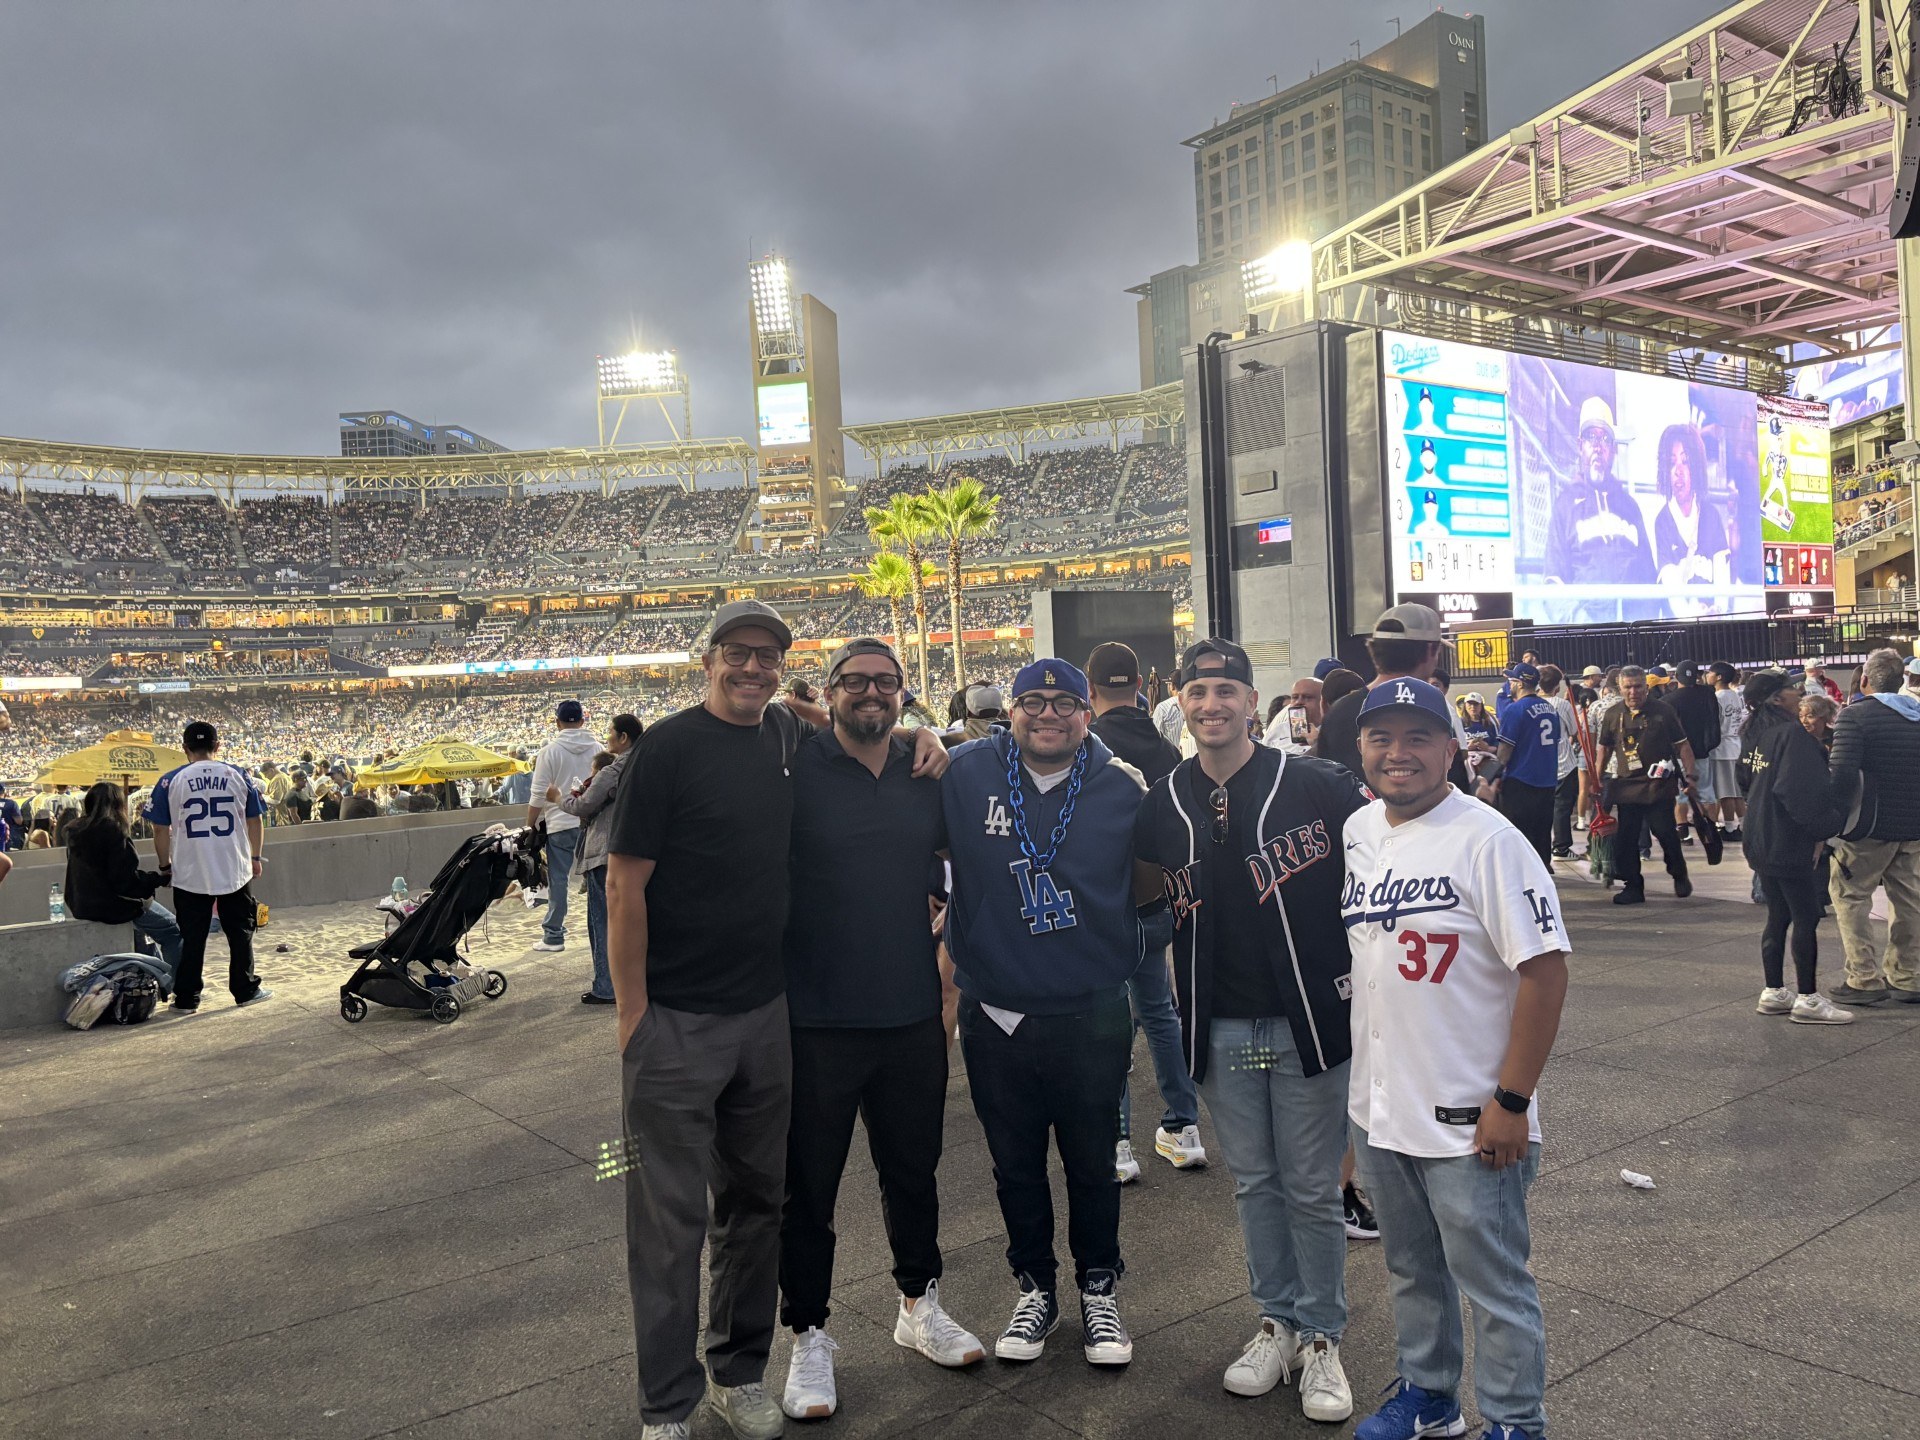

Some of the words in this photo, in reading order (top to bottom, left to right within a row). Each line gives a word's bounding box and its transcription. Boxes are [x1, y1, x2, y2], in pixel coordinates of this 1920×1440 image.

[1395, 447, 1401, 469] 2
[1396, 499, 1403, 521] 3
[1427, 552, 1434, 571] R
[1452, 552, 1459, 571] H
[1478, 553, 1484, 571] E
[107, 603, 143, 611] JERRY
[147, 603, 202, 611] COLEMAN
[276, 602, 318, 610] CENTER
[1438, 594, 1478, 612] NOVA
[1044, 670, 1056, 685] LA
[1395, 682, 1415, 705] LA
[1540, 718, 1554, 746] 2
[187, 776, 229, 793] EDMAN
[183, 795, 235, 839] 25
[984, 795, 1012, 837] LA
[1009, 857, 1078, 935] LA
[1341, 868, 1460, 932] Dodgers
[1522, 888, 1558, 934] LA
[1397, 929, 1460, 985] 37
